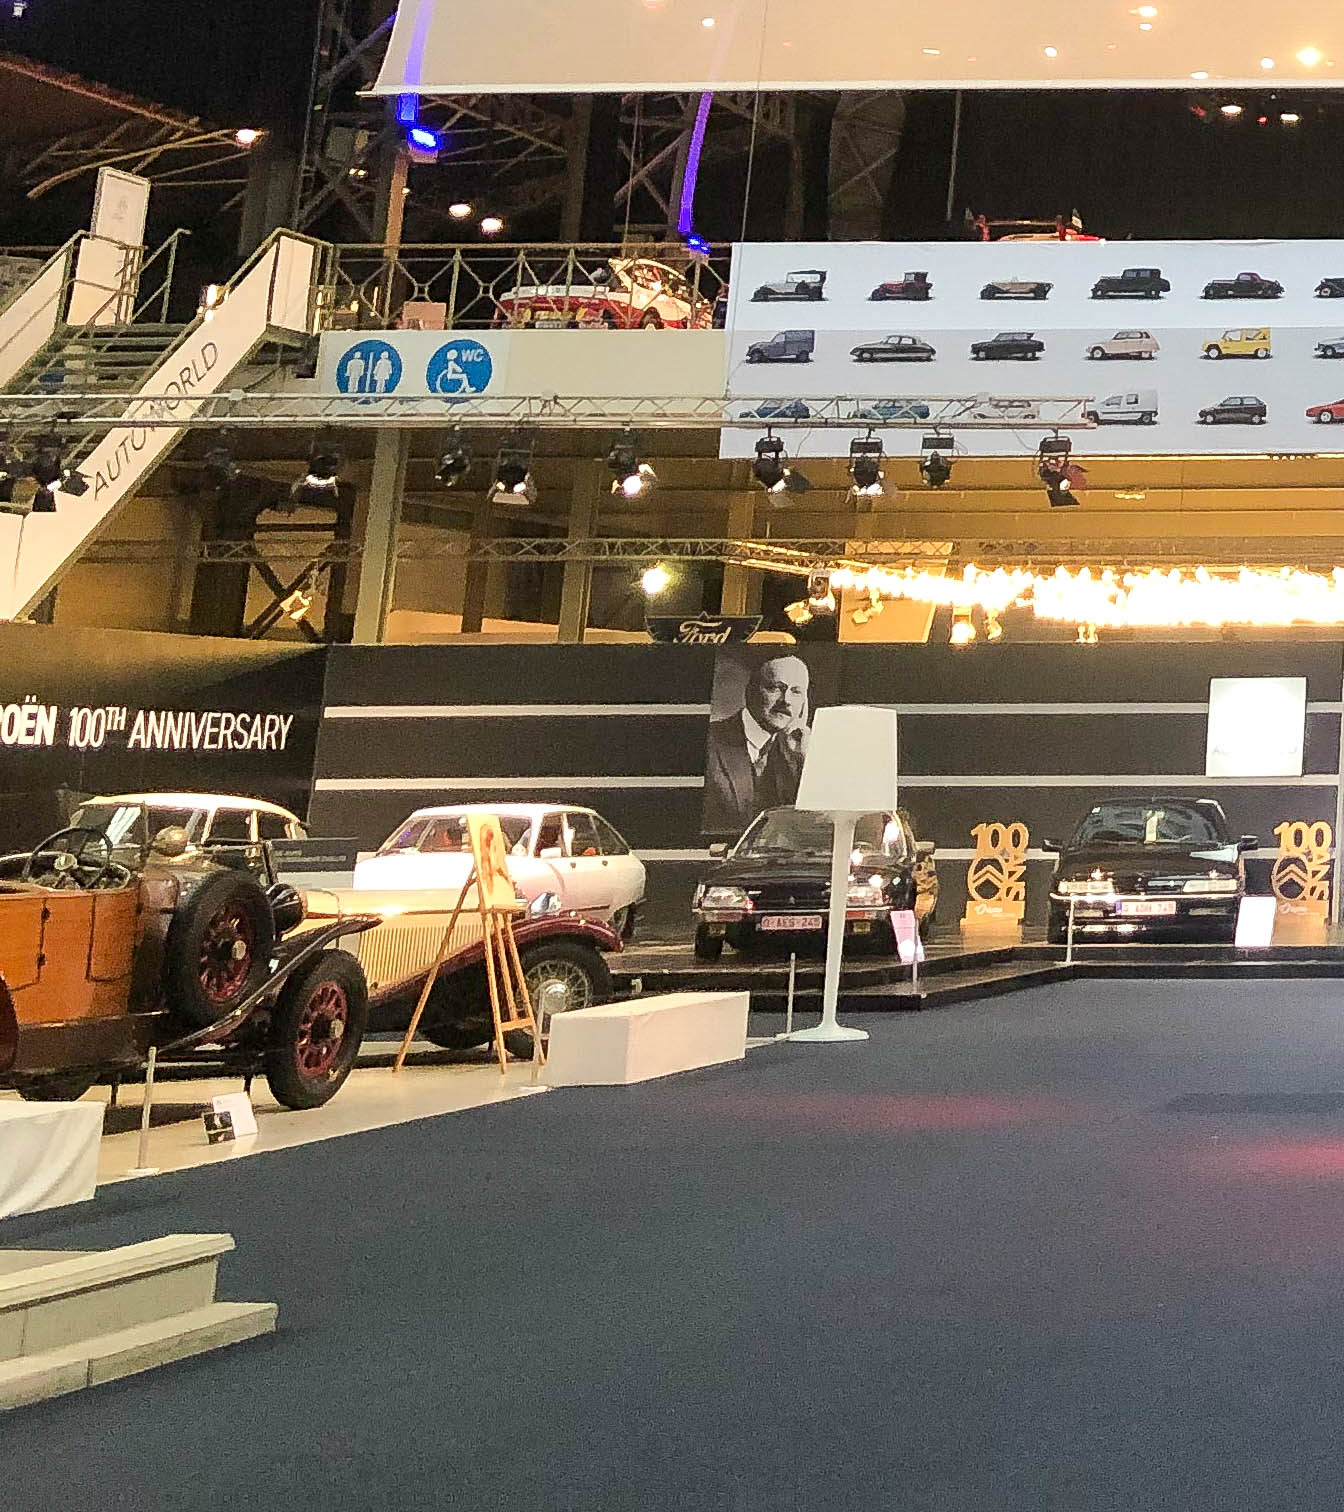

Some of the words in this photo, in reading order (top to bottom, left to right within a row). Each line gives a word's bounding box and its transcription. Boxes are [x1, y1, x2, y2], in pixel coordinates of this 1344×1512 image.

[461, 349, 484, 362] WC
[673, 620, 732, 644] Ford
[0, 695, 58, 746] OËN
[67, 706, 128, 749] 100TH
[127, 710, 294, 751] ANNIVERSARY
[970, 822, 1029, 855] 100
[1273, 821, 1332, 854] 100
